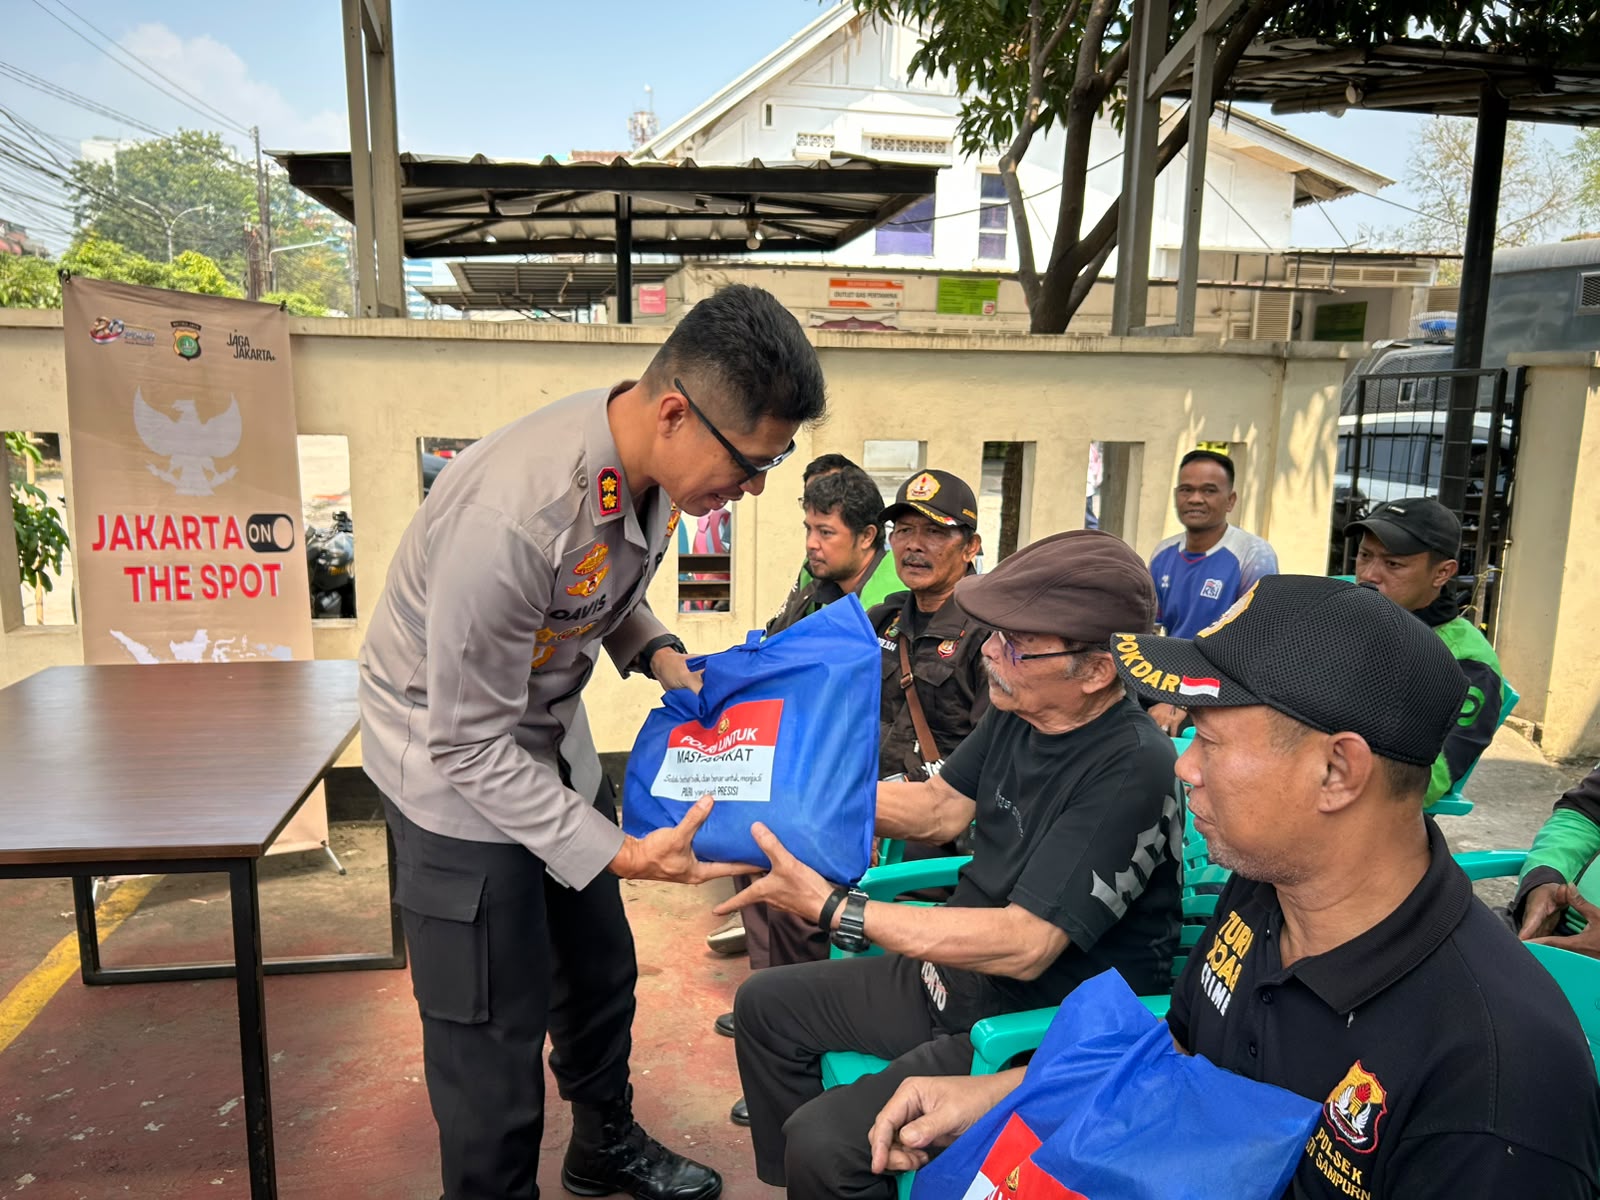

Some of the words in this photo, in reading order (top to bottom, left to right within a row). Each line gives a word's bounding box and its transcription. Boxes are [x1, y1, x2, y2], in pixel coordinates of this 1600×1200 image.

[226, 331, 250, 348] JAGA
[92, 514, 246, 552] JAKARTA
[248, 523, 272, 543] ON
[123, 565, 195, 603] THE
[200, 562, 283, 600] SPOT
[549, 594, 607, 620] DAVIS
[1115, 633, 1181, 693] POKDAR
[718, 727, 759, 752] UNTUK
[717, 786, 738, 796] PRESISI
[1315, 1126, 1362, 1185] POLSEK
